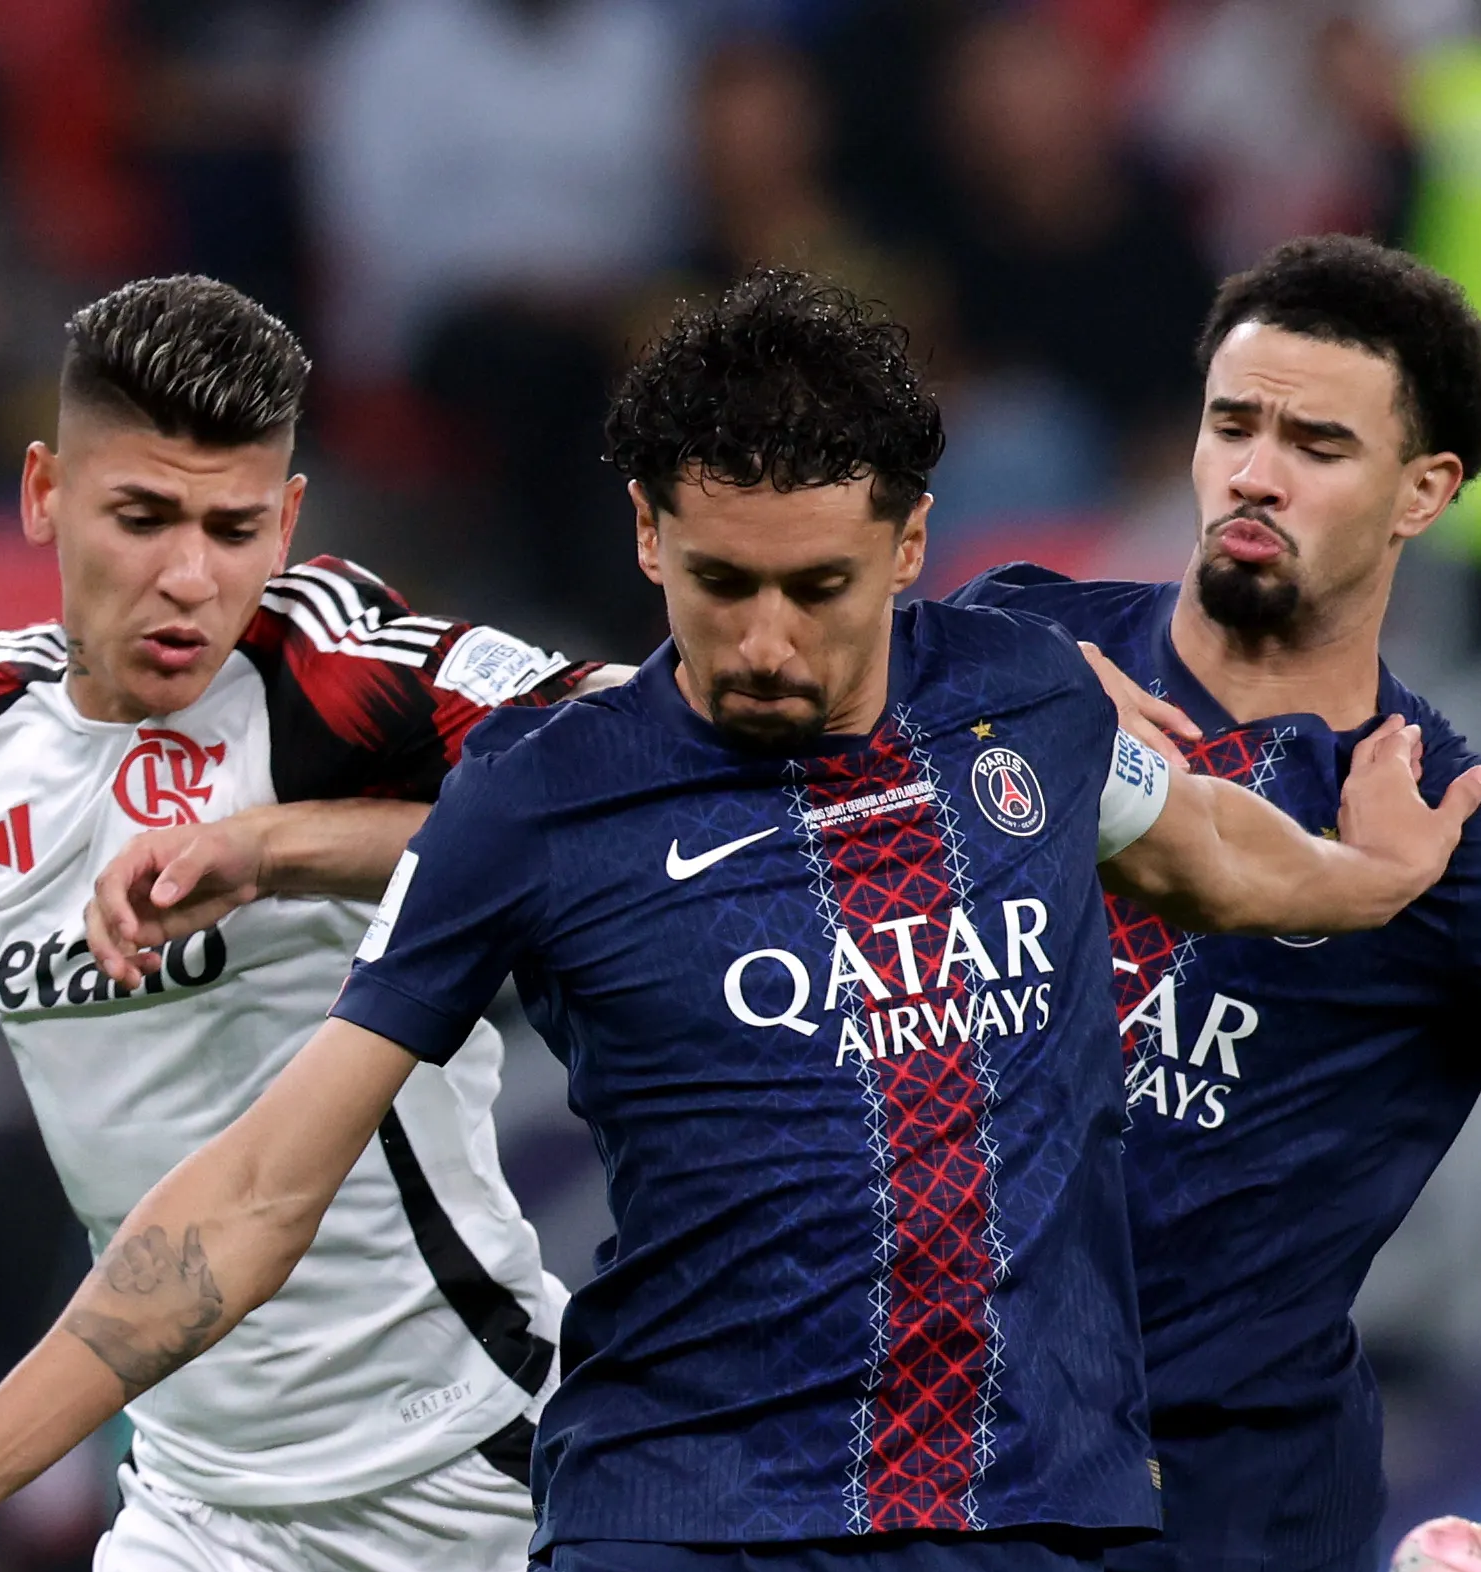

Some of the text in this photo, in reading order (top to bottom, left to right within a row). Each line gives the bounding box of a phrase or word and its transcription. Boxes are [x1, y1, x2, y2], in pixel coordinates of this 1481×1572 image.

[473, 644, 518, 679] UNITES
[978, 752, 1022, 777] PARIS
[803, 804, 826, 823] PARIS
[820, 814, 855, 828] RAYYAN
[870, 799, 915, 816] DECEMBER
[723, 898, 1055, 1037] QATAR
[835, 982, 1052, 1068] AIRWAYS
[399, 1380, 474, 1424] HEAT RDY
